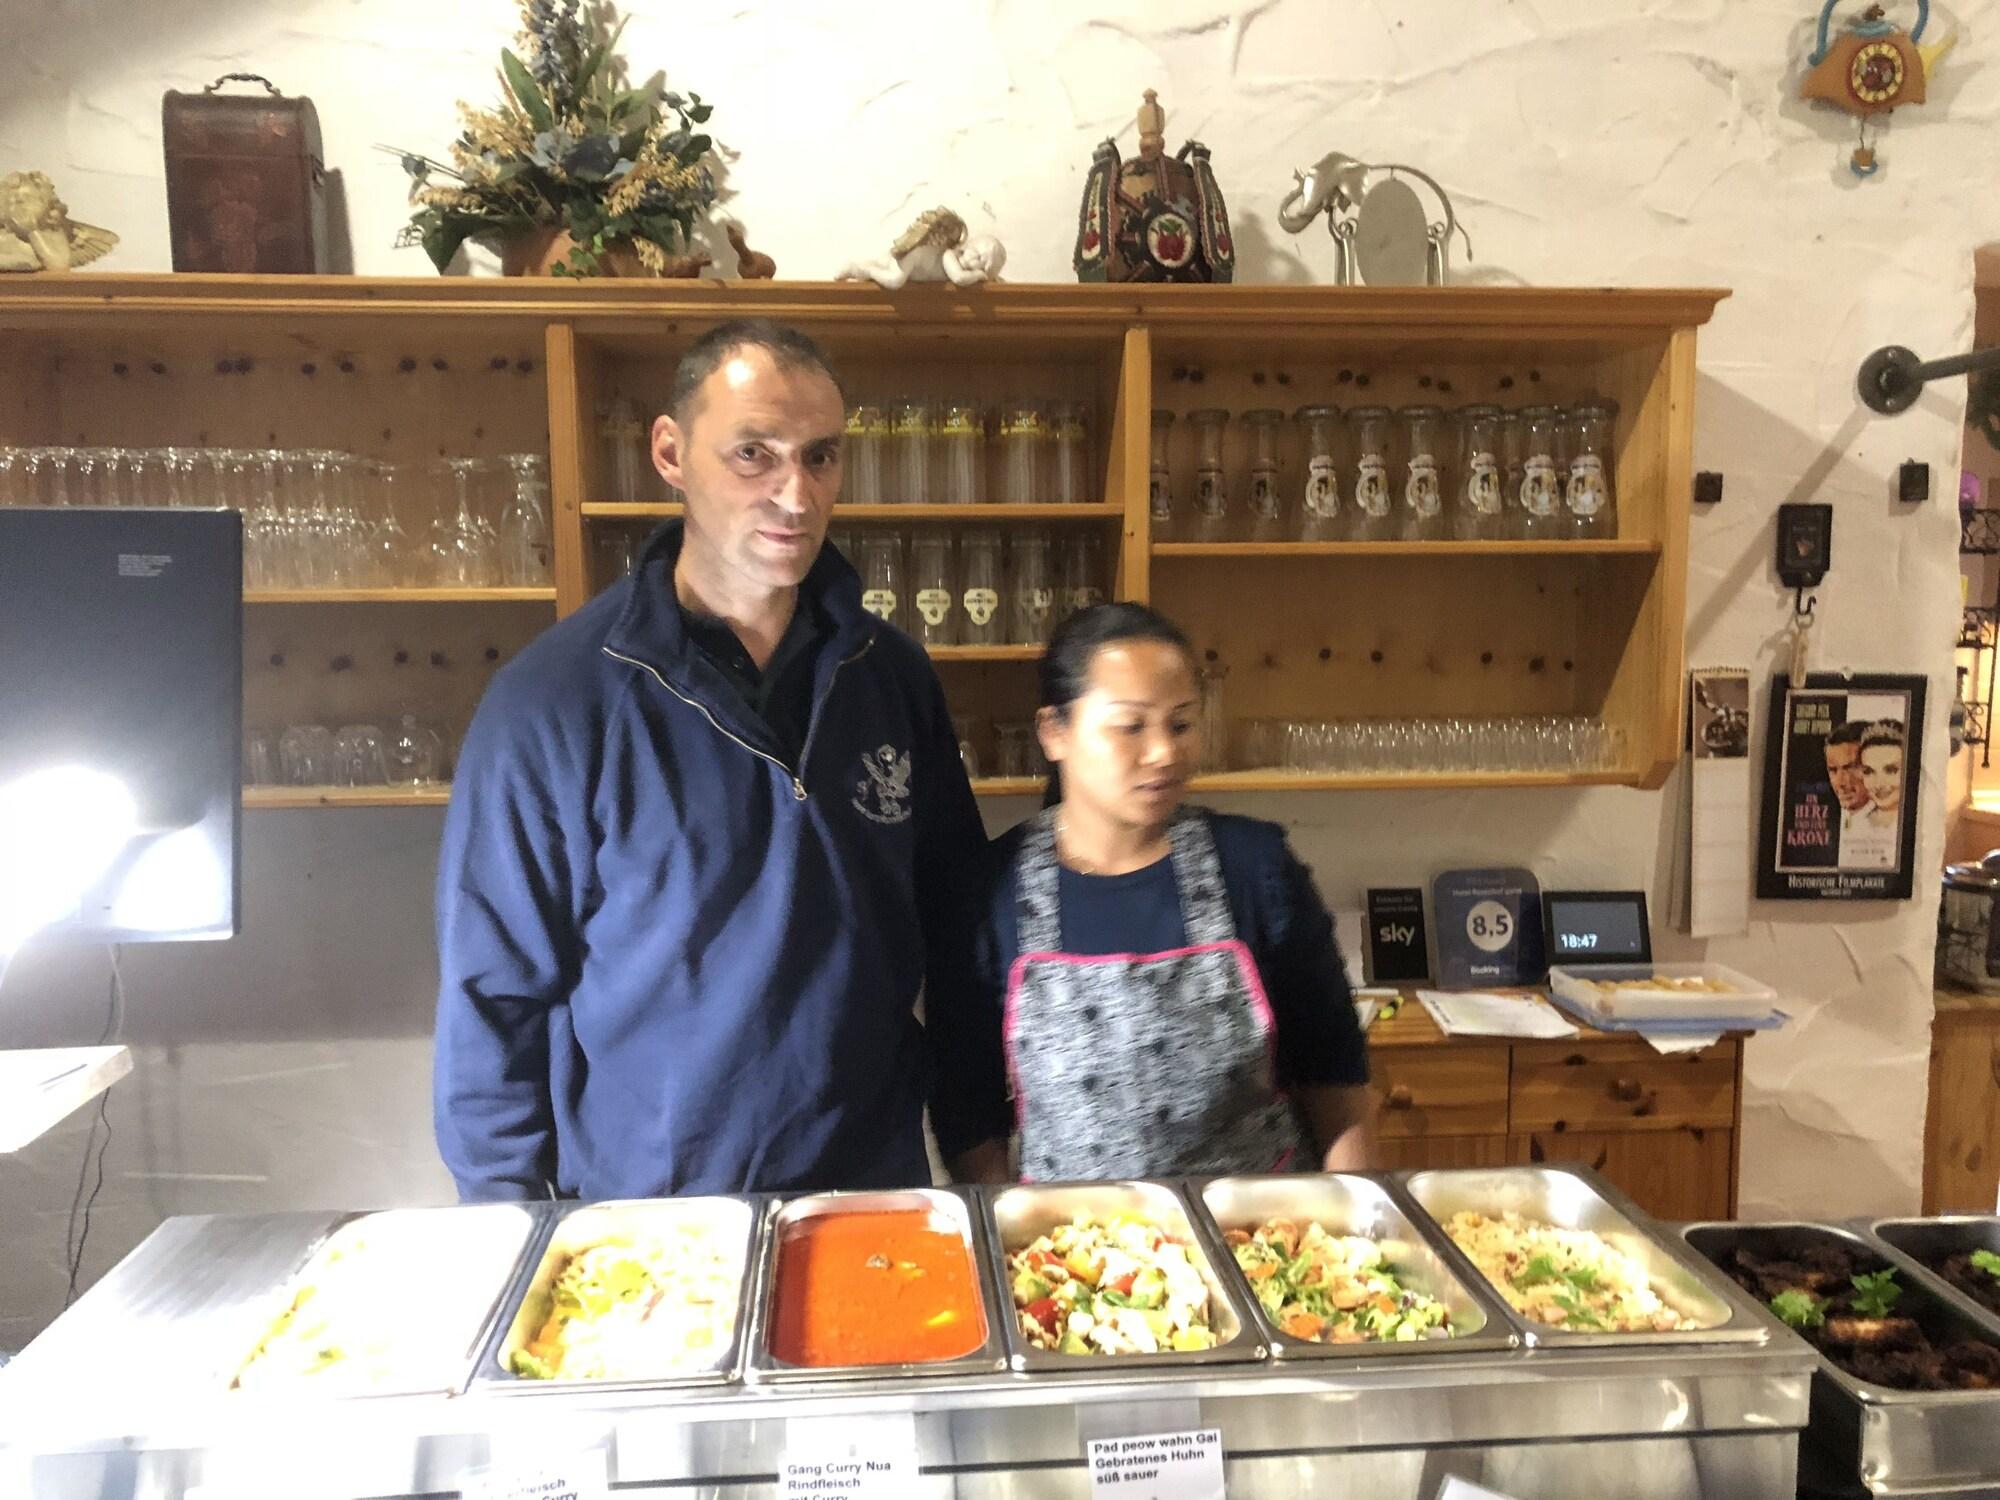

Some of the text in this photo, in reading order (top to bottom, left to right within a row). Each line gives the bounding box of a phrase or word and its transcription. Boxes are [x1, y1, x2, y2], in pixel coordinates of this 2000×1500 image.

[1795, 805, 1828, 818] HERZ
[1788, 831, 1829, 846] KRONE
[1473, 915, 1509, 938] 8,5
[1380, 922, 1415, 947] sky
[1561, 934, 1598, 948] 18:47
[1095, 1442, 1118, 1454] Pad
[1122, 1440, 1155, 1454] peow
[1159, 1436, 1192, 1447] wahn
[1095, 1449, 1204, 1469] Gebratenes Huhn
[787, 1461, 891, 1476] Gang Curry Nua
[788, 1478, 861, 1490] Rindfleisch
[1097, 1469, 1158, 1484] süß sauer
